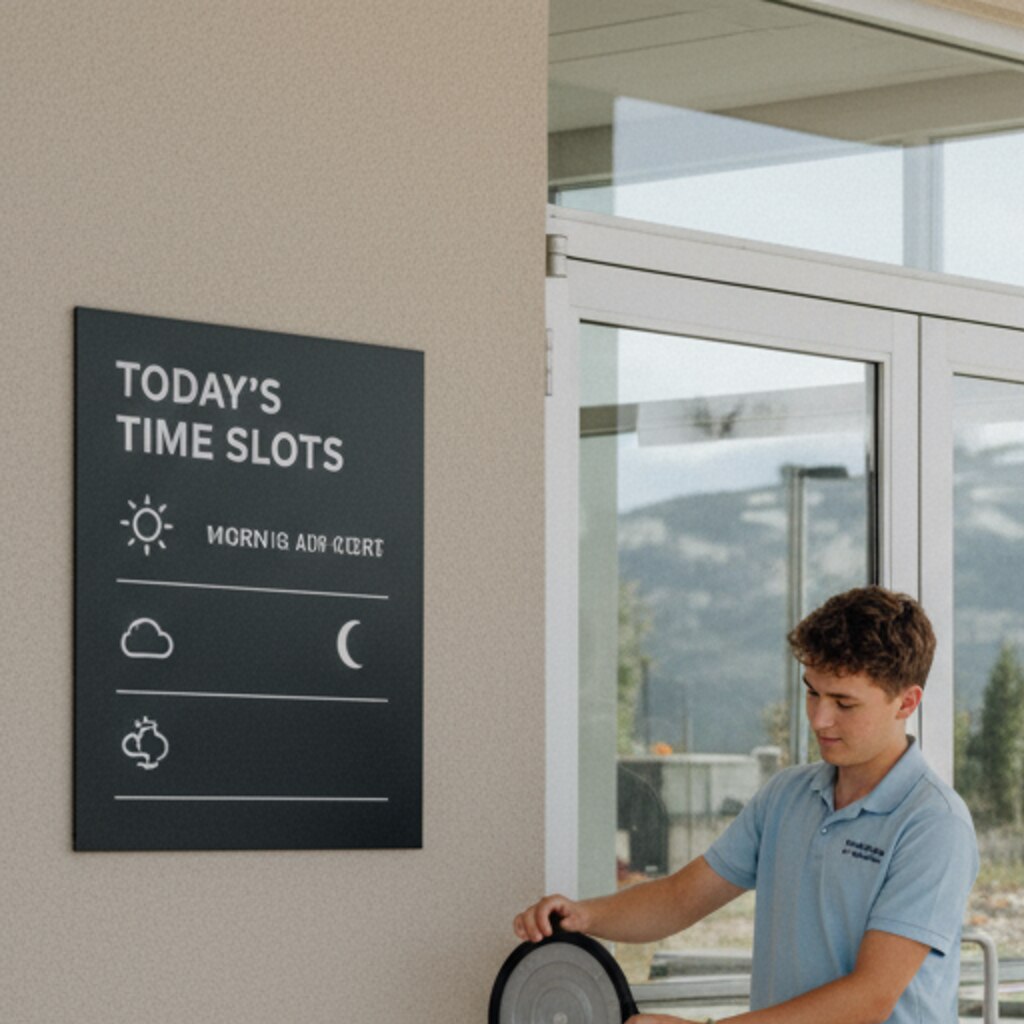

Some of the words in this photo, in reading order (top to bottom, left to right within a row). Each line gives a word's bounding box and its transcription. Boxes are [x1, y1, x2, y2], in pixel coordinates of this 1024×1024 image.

[115, 360, 282, 415] TODAY'S
[115, 414, 214, 461] TIME
[226, 426, 344, 473] SLOTS
